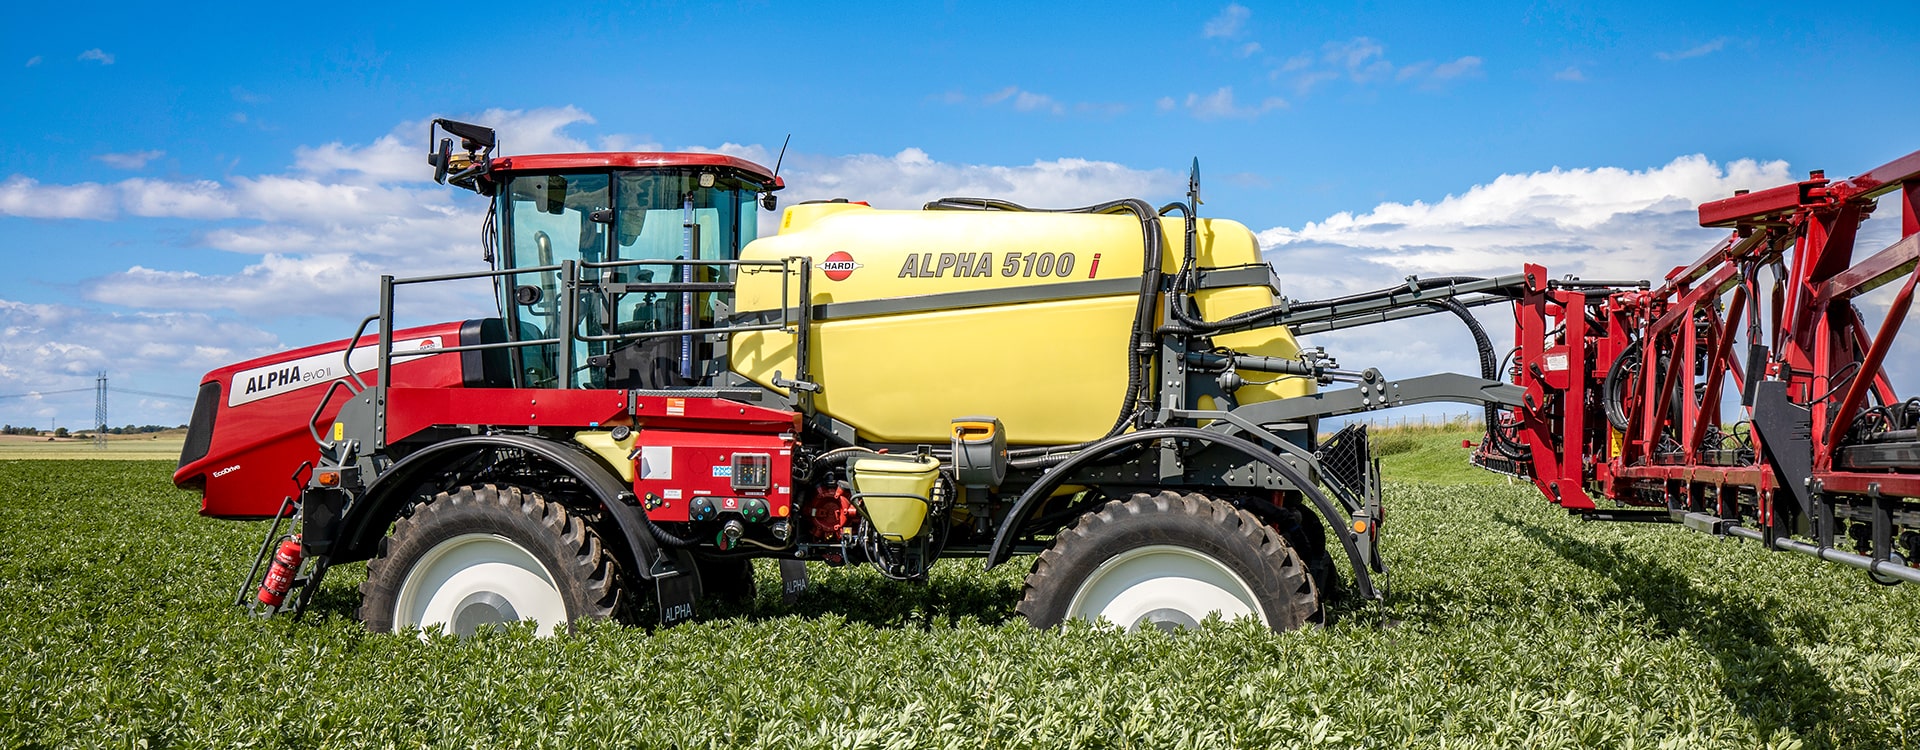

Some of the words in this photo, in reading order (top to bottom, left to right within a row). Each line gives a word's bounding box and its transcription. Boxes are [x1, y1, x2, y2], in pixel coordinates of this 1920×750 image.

[824, 262, 854, 270] HARDI
[898, 252, 992, 278] ALPHA
[1001, 252, 1075, 278] 5100
[1088, 253, 1101, 279] i
[245, 365, 301, 395] ALPHA
[302, 368, 325, 382] evo
[212, 464, 241, 478] EcoDrive
[785, 578, 807, 594] ALPHA
[665, 602, 692, 623] ALPHA
